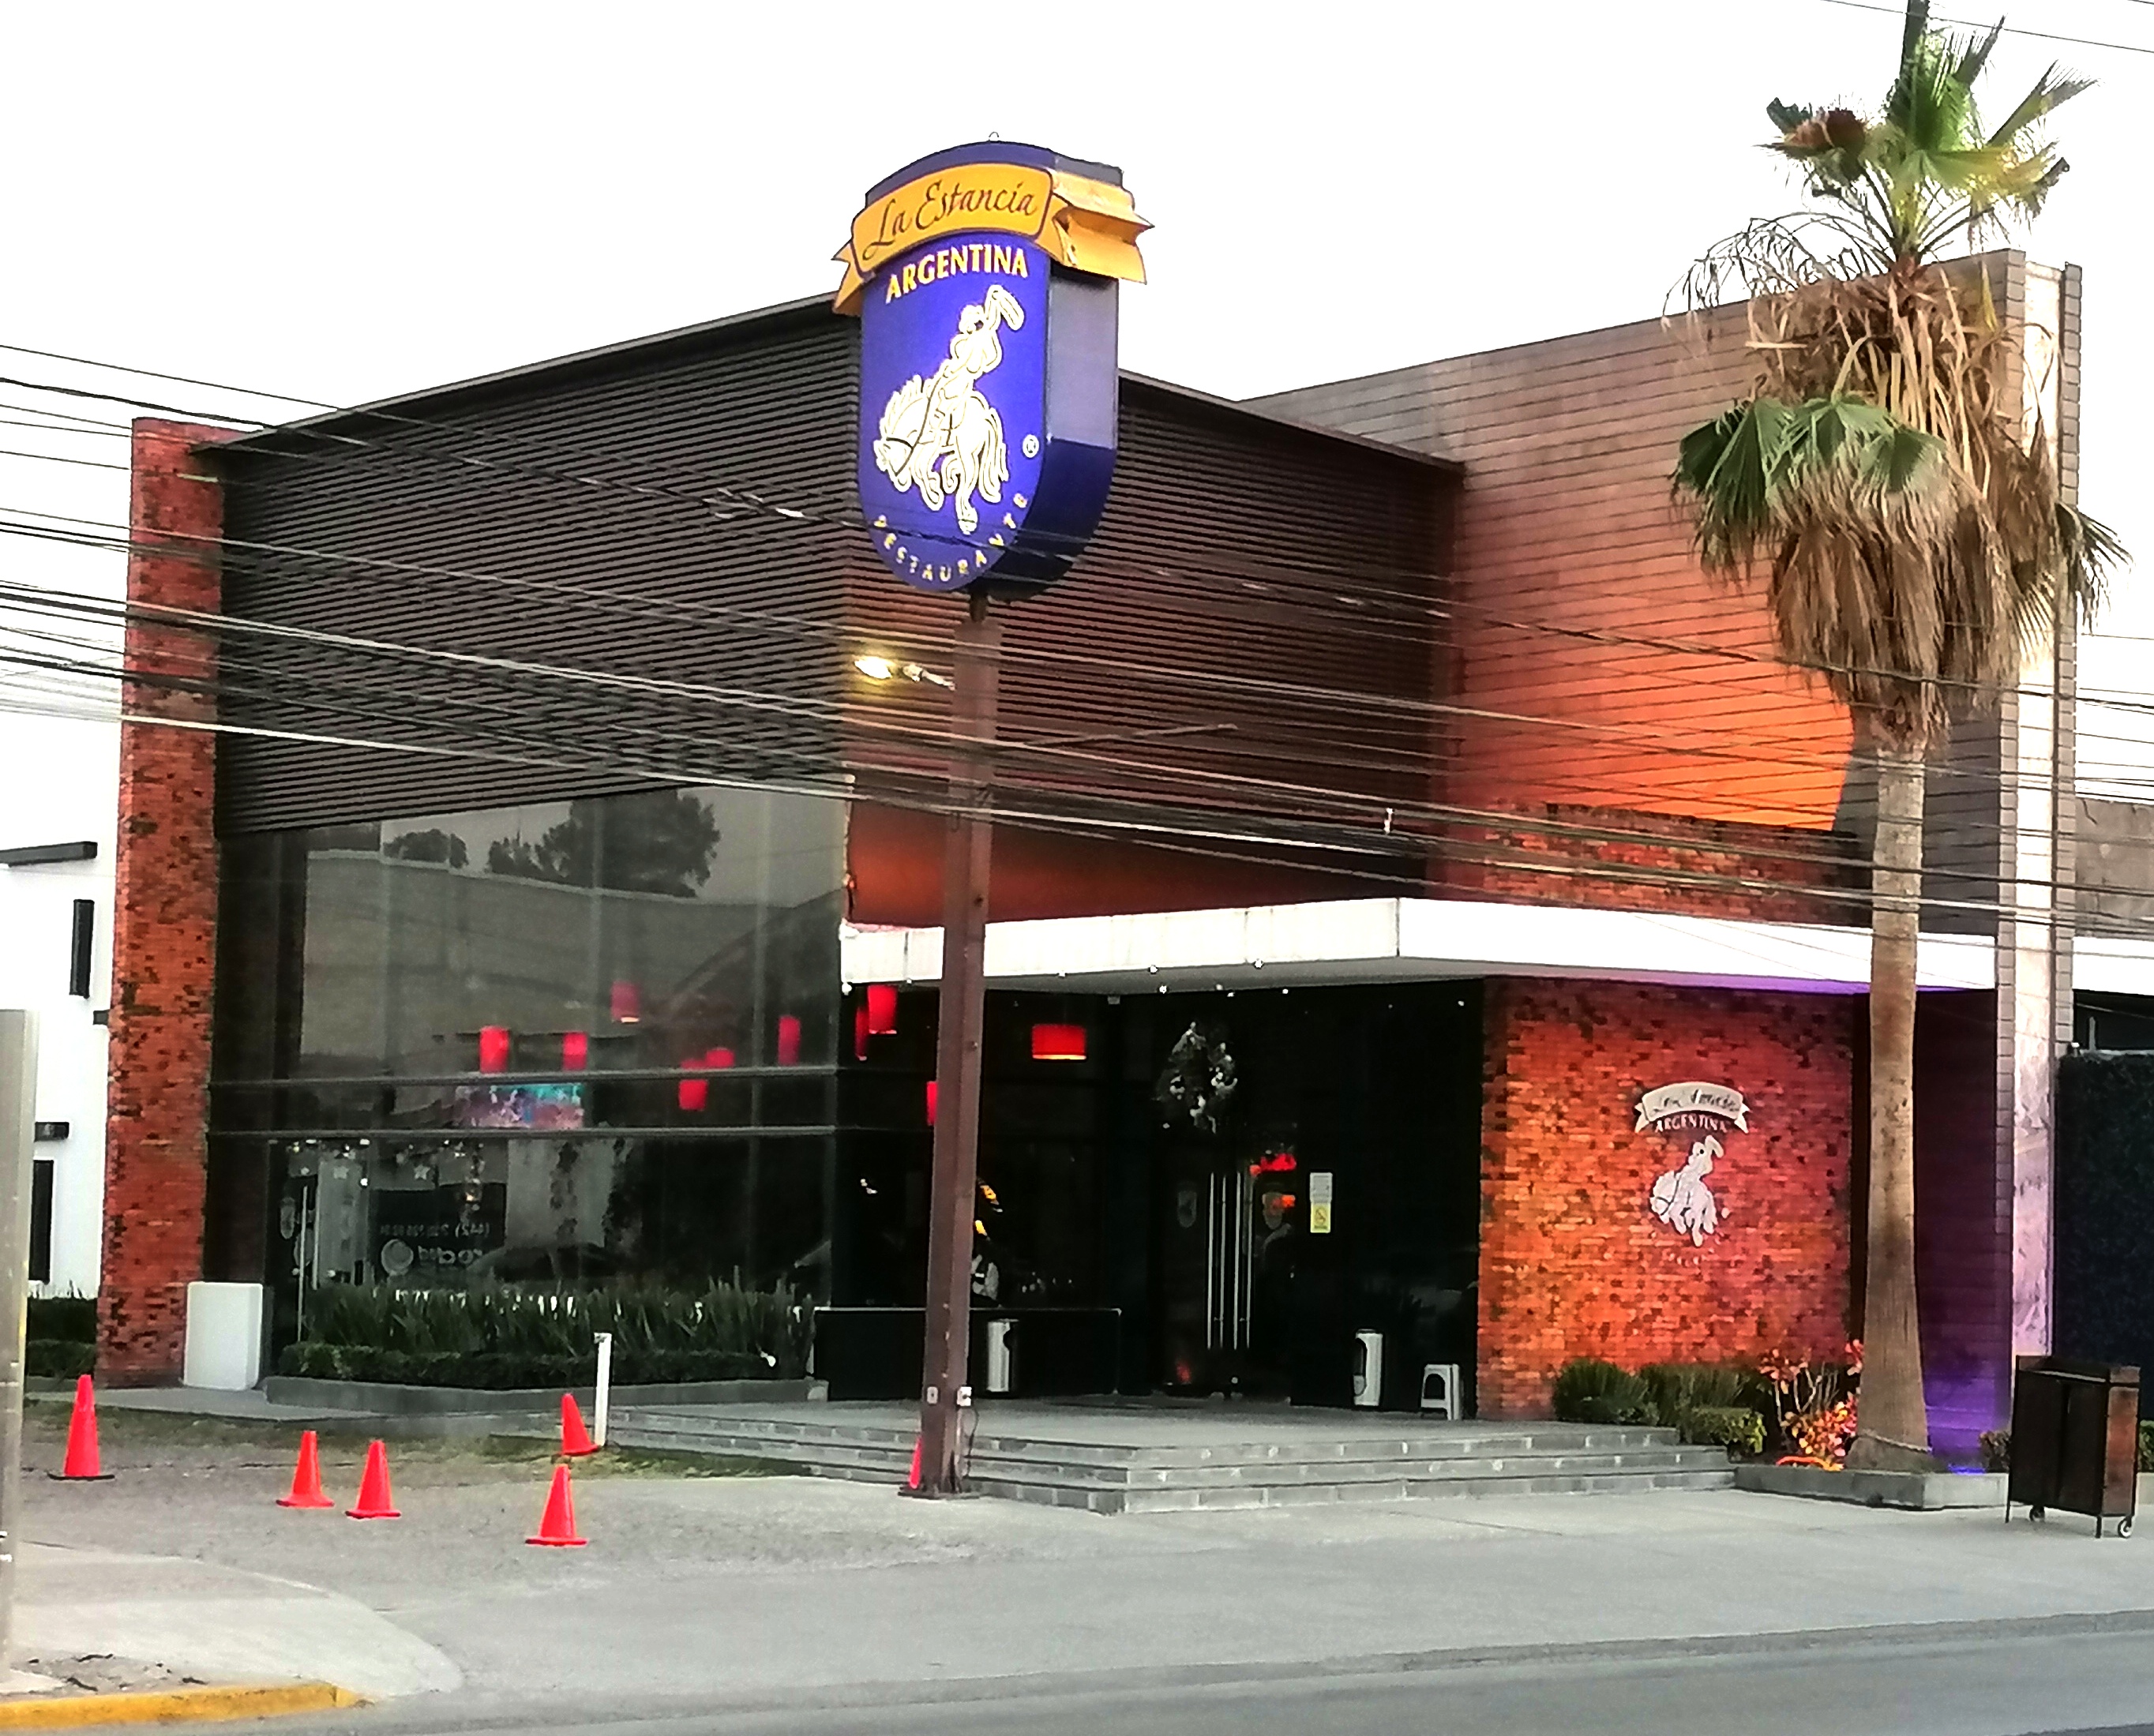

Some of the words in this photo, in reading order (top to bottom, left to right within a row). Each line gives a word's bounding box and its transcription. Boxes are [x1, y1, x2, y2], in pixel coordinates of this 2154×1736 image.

[861, 197, 913, 261] La
[915, 179, 1038, 231] Estancia
[884, 243, 1028, 305] ARGENTINA
[872, 493, 1028, 583] RESTAURANTE
[1654, 1113, 1728, 1134] ARGENTINA
